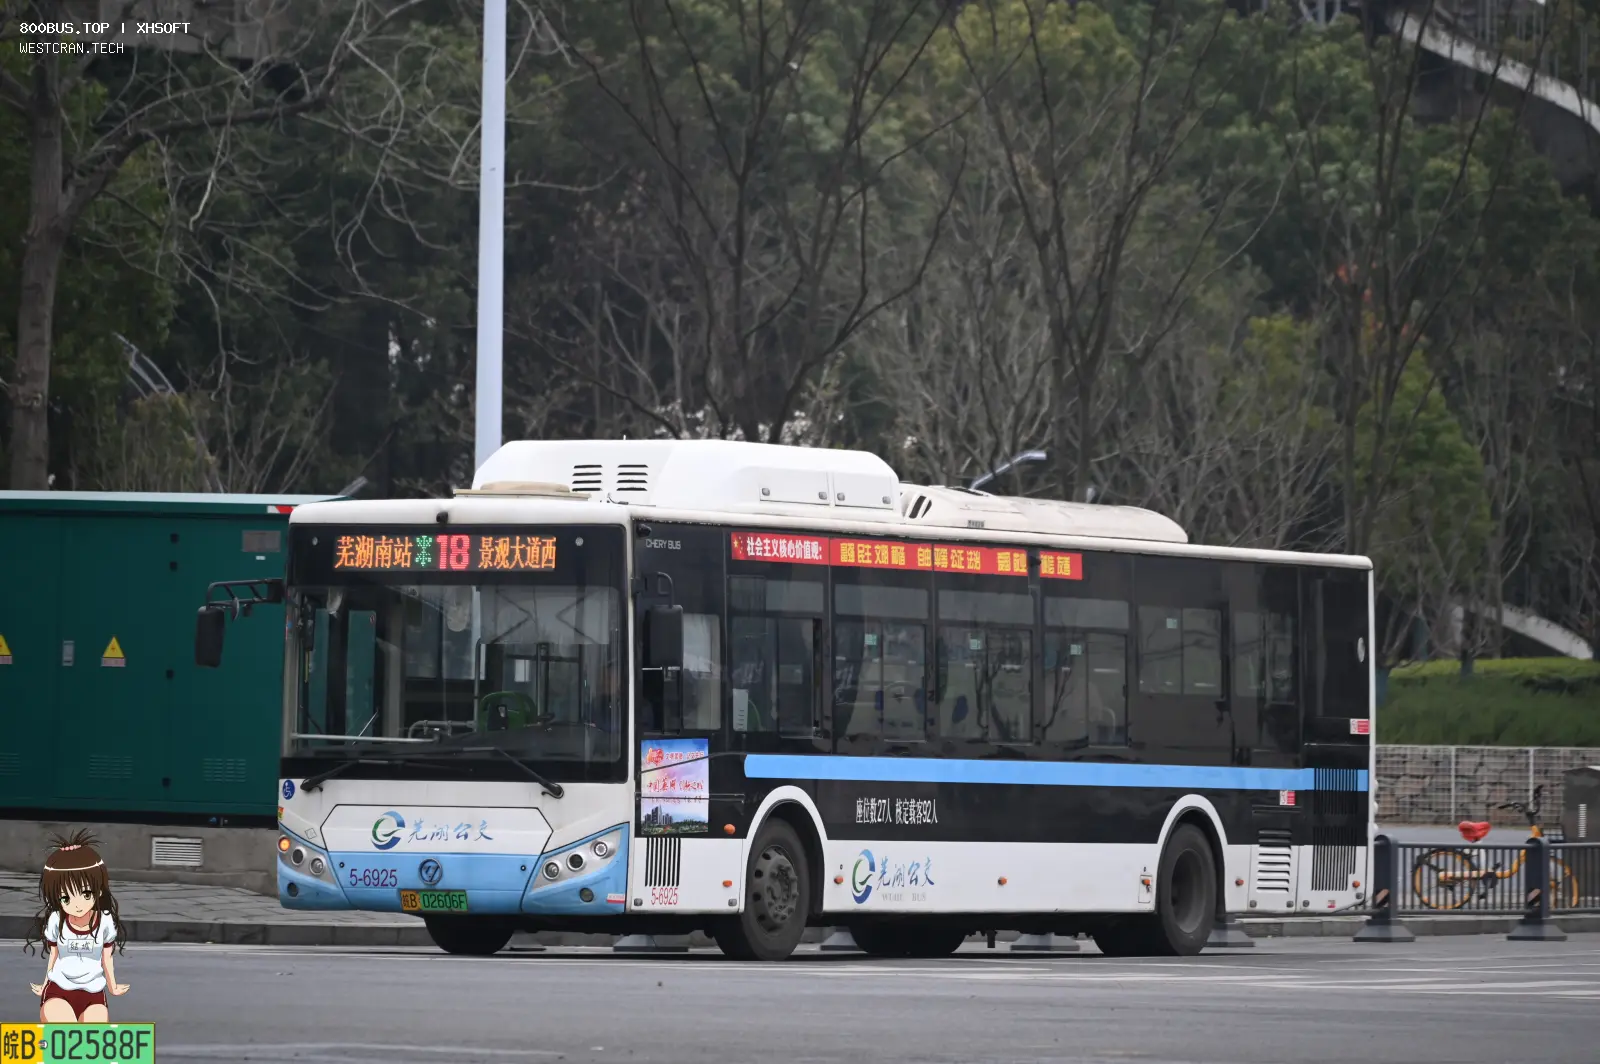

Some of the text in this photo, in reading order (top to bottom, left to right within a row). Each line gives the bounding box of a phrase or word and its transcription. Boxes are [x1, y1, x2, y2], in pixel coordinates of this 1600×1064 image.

[334, 535, 557, 569] 芜湖南站 18 景观大道西
[645, 538, 681, 550] CHERY BUS
[856, 797, 892, 824] 座位数27人
[350, 868, 398, 888] 5-6925
[422, 893, 465, 909] 02606F
[651, 887, 679, 905] 5-6925
